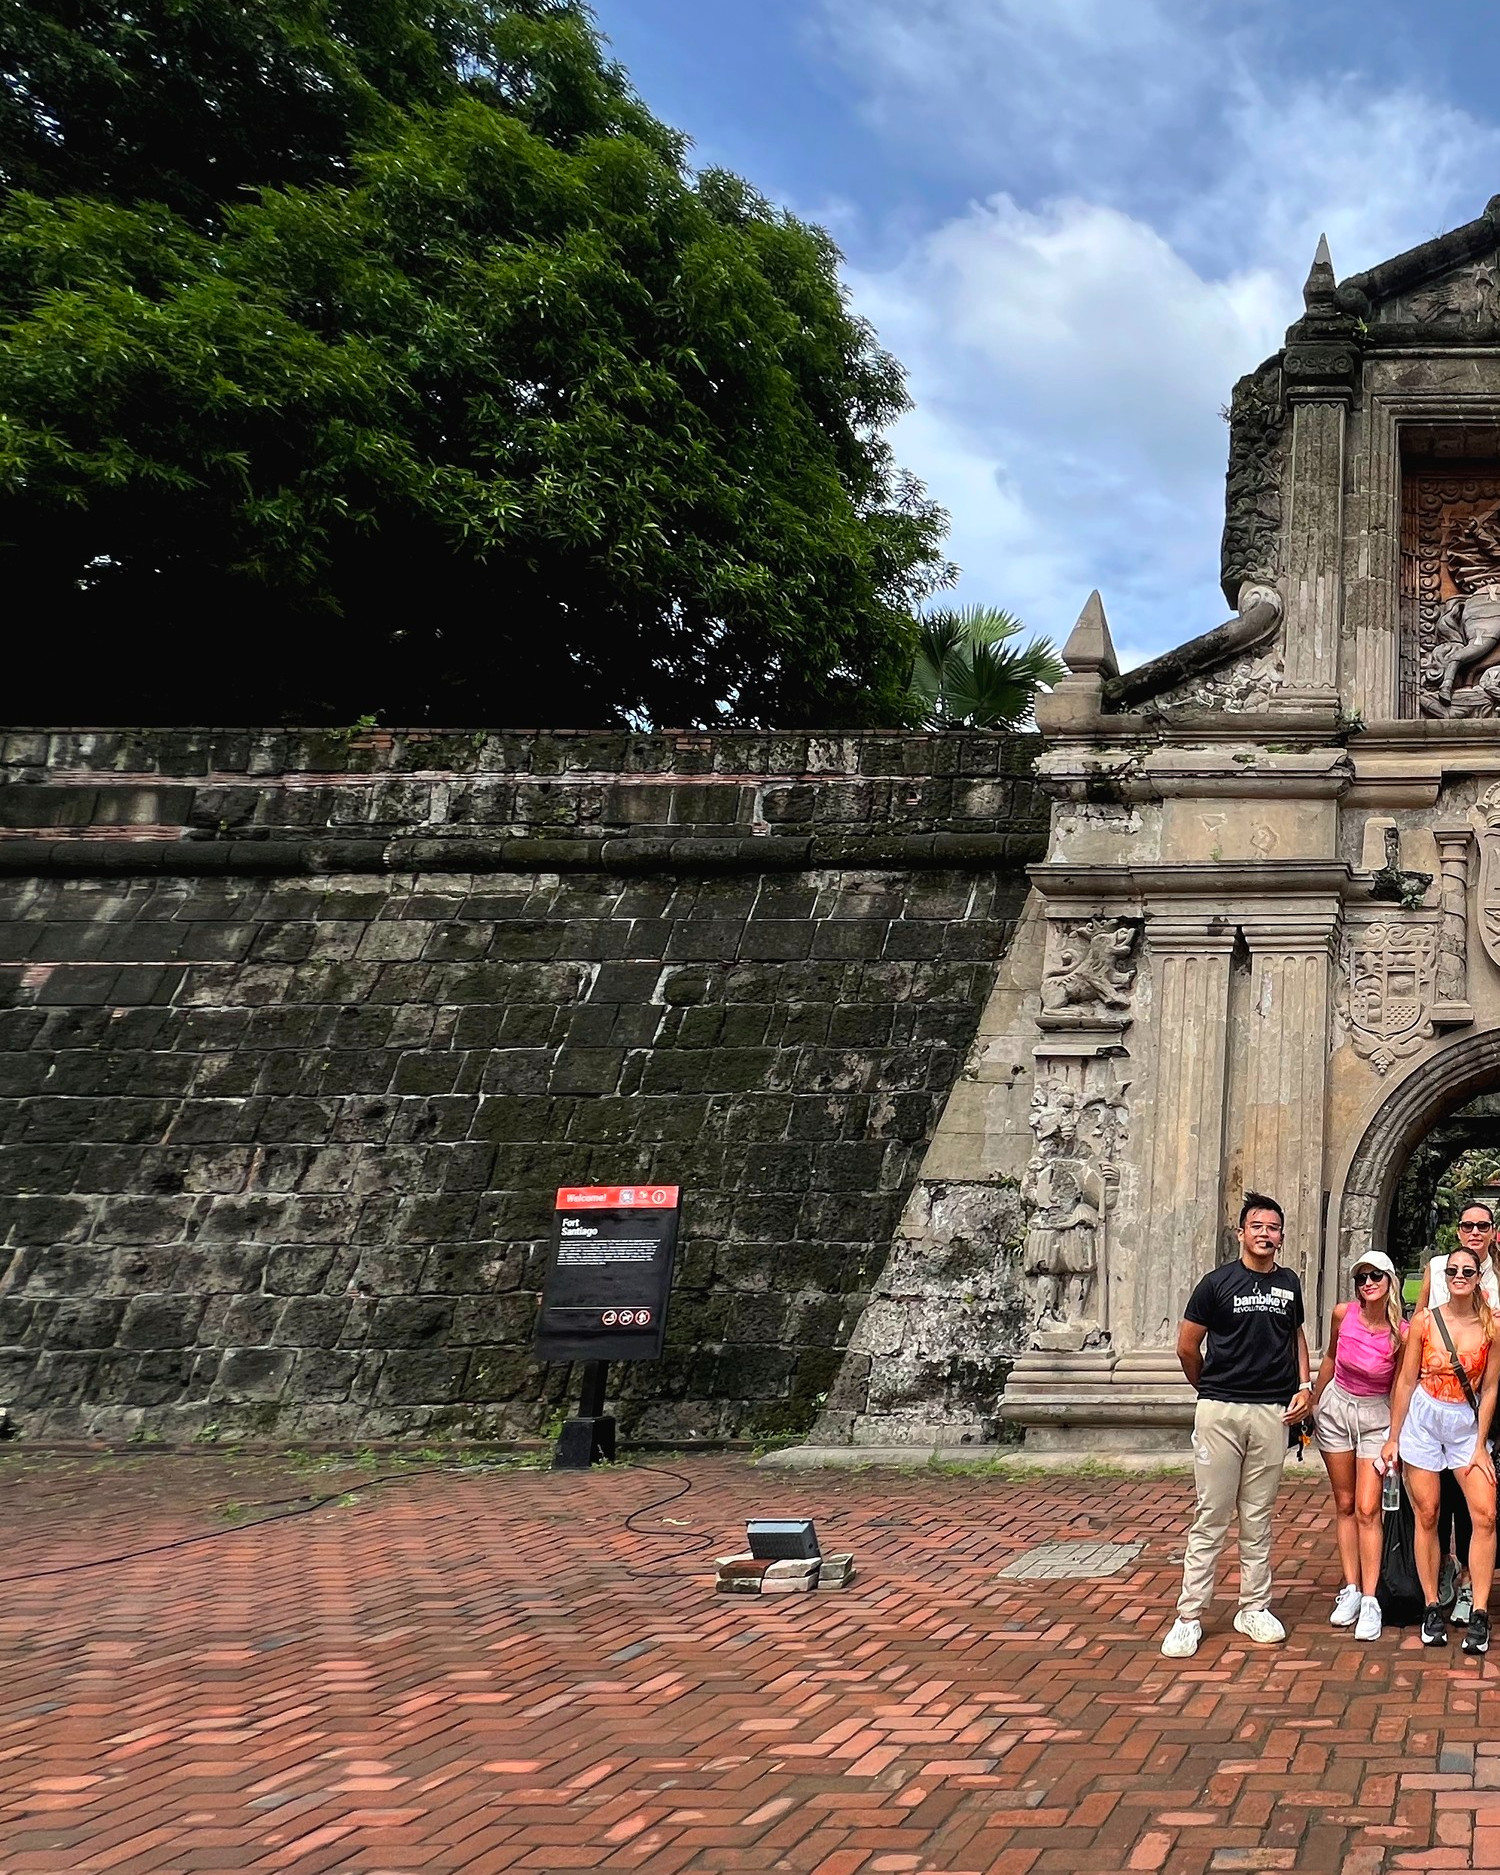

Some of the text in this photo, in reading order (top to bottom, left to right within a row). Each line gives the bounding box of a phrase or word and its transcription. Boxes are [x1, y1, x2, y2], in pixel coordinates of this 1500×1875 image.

[566, 1193, 607, 1203] Welcome!
[562, 1218, 580, 1227] Fort
[561, 1227, 598, 1237] Santiago
[1233, 1293, 1280, 1307] bambike
